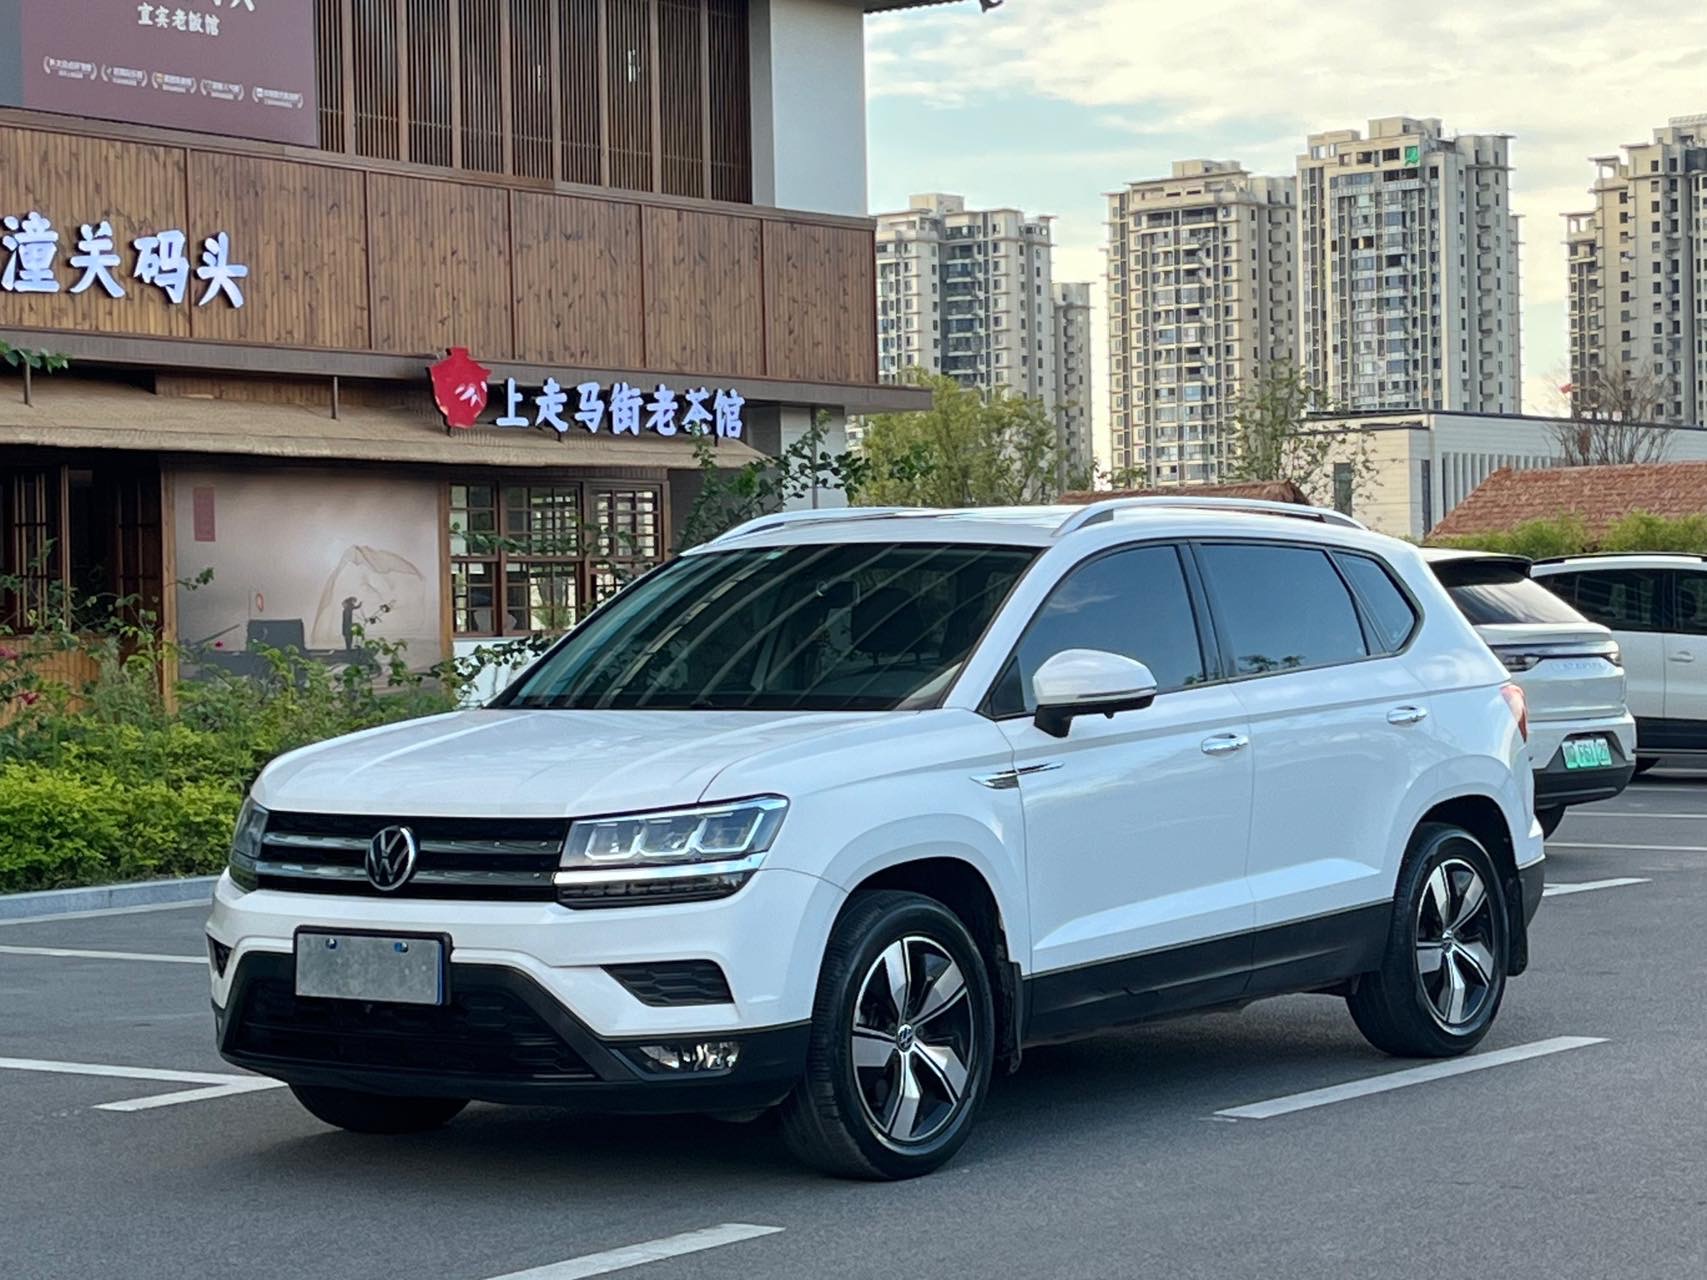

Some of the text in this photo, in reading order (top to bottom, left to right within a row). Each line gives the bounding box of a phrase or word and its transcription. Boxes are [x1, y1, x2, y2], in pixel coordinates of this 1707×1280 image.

[137, 2, 220, 36] 宜宾老饭馆
[1, 211, 248, 308] 潼关码头
[496, 377, 746, 438] 上走马街老茶馆
